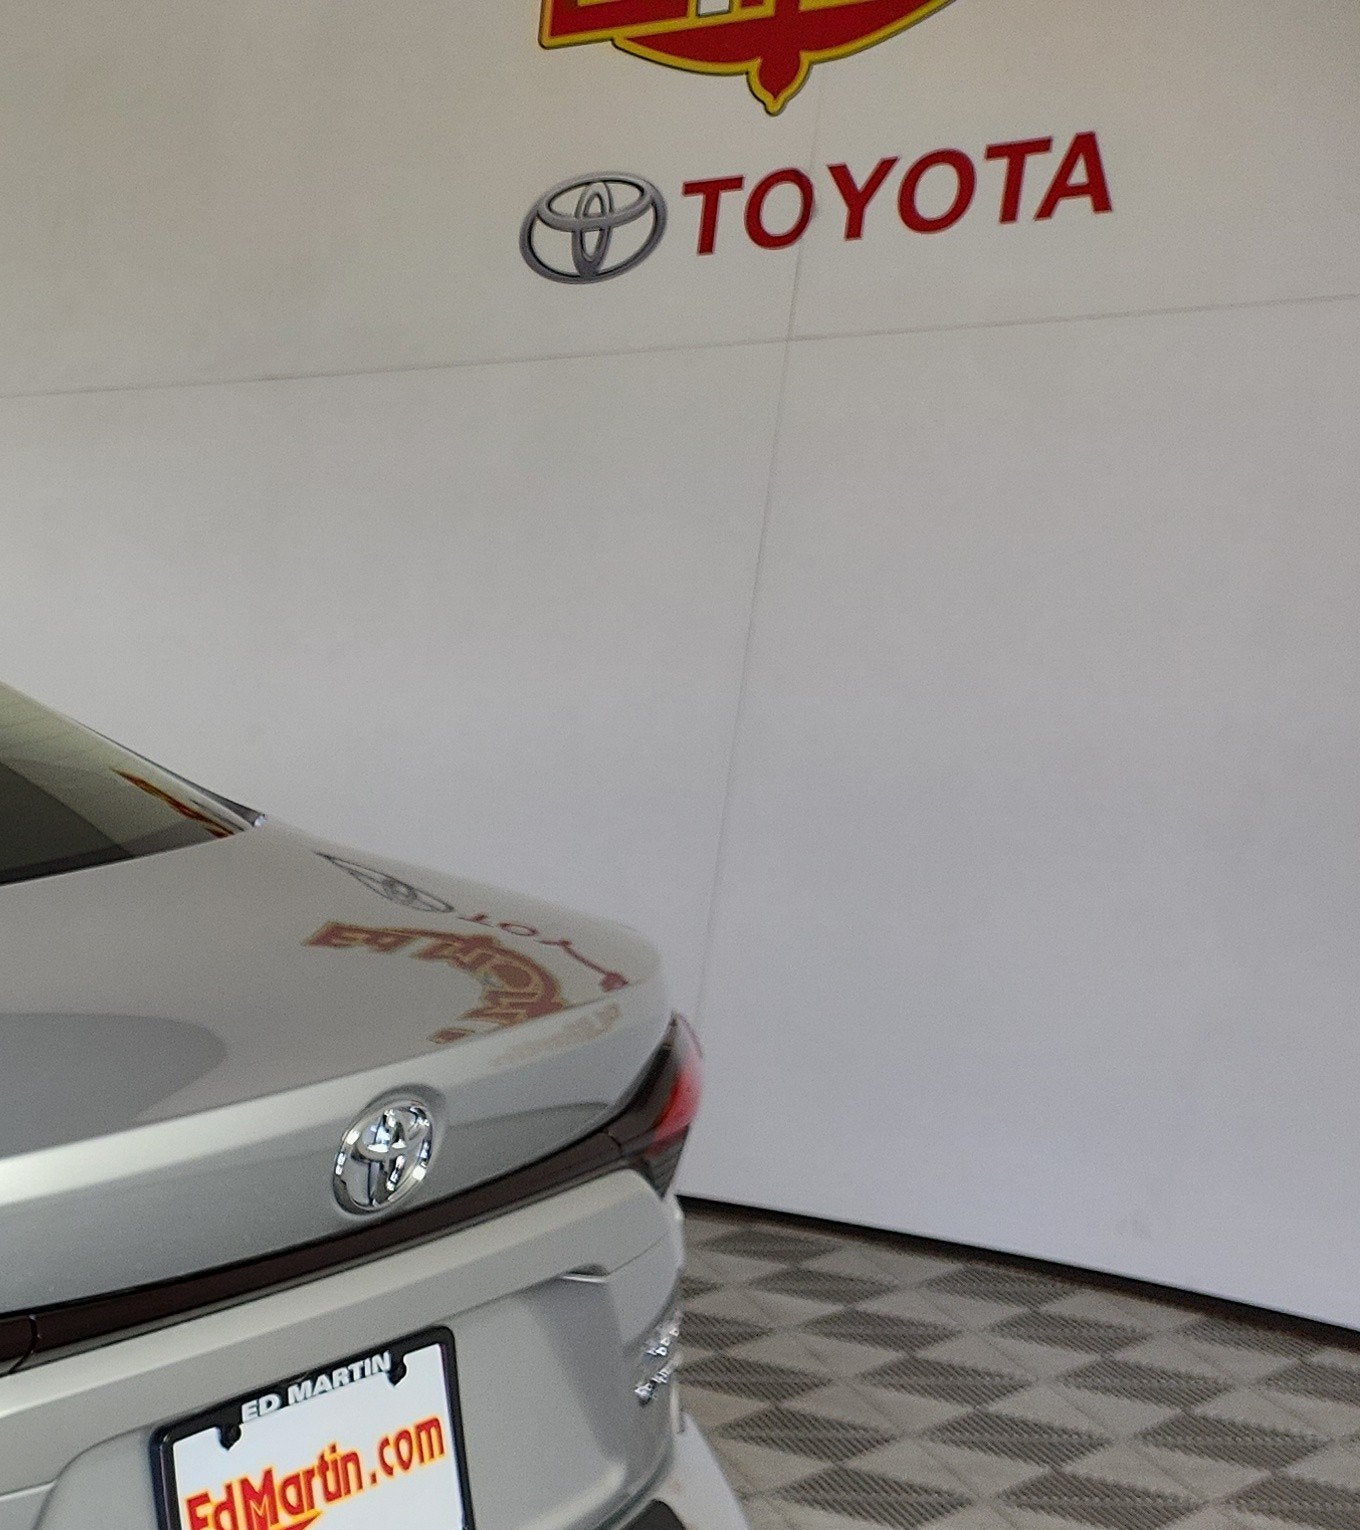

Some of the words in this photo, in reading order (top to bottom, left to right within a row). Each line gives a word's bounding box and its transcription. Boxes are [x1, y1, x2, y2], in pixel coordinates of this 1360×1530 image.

[682, 130, 1114, 256] TOYOTA
[241, 1393, 281, 1423] ED
[287, 1350, 392, 1406] MARTIN
